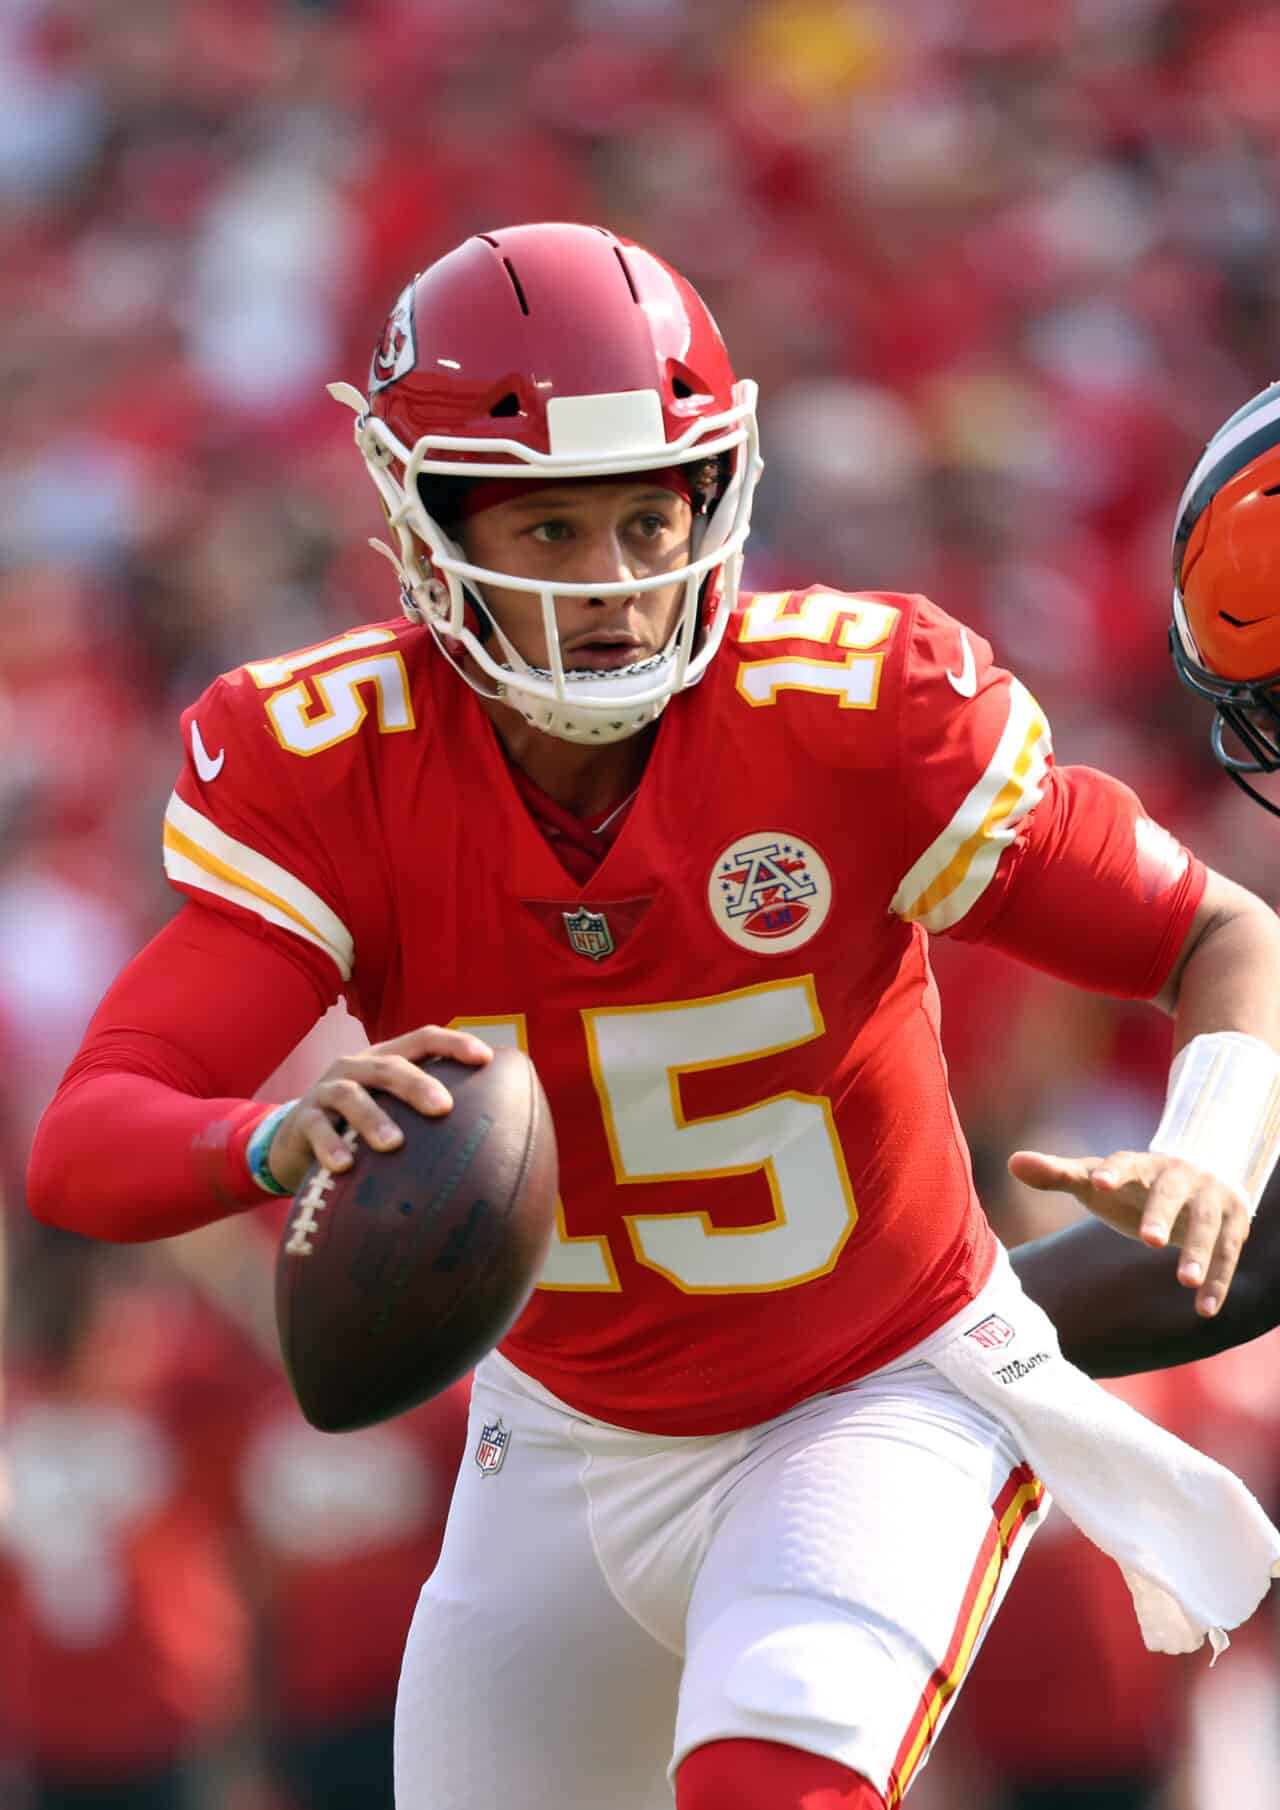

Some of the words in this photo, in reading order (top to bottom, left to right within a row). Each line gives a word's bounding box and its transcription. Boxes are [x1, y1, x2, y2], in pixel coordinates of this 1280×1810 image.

[736, 592, 900, 710] 15
[244, 628, 416, 758] 15
[968, 1321, 1011, 1349] NFL
[479, 1442, 500, 1468] NFL
